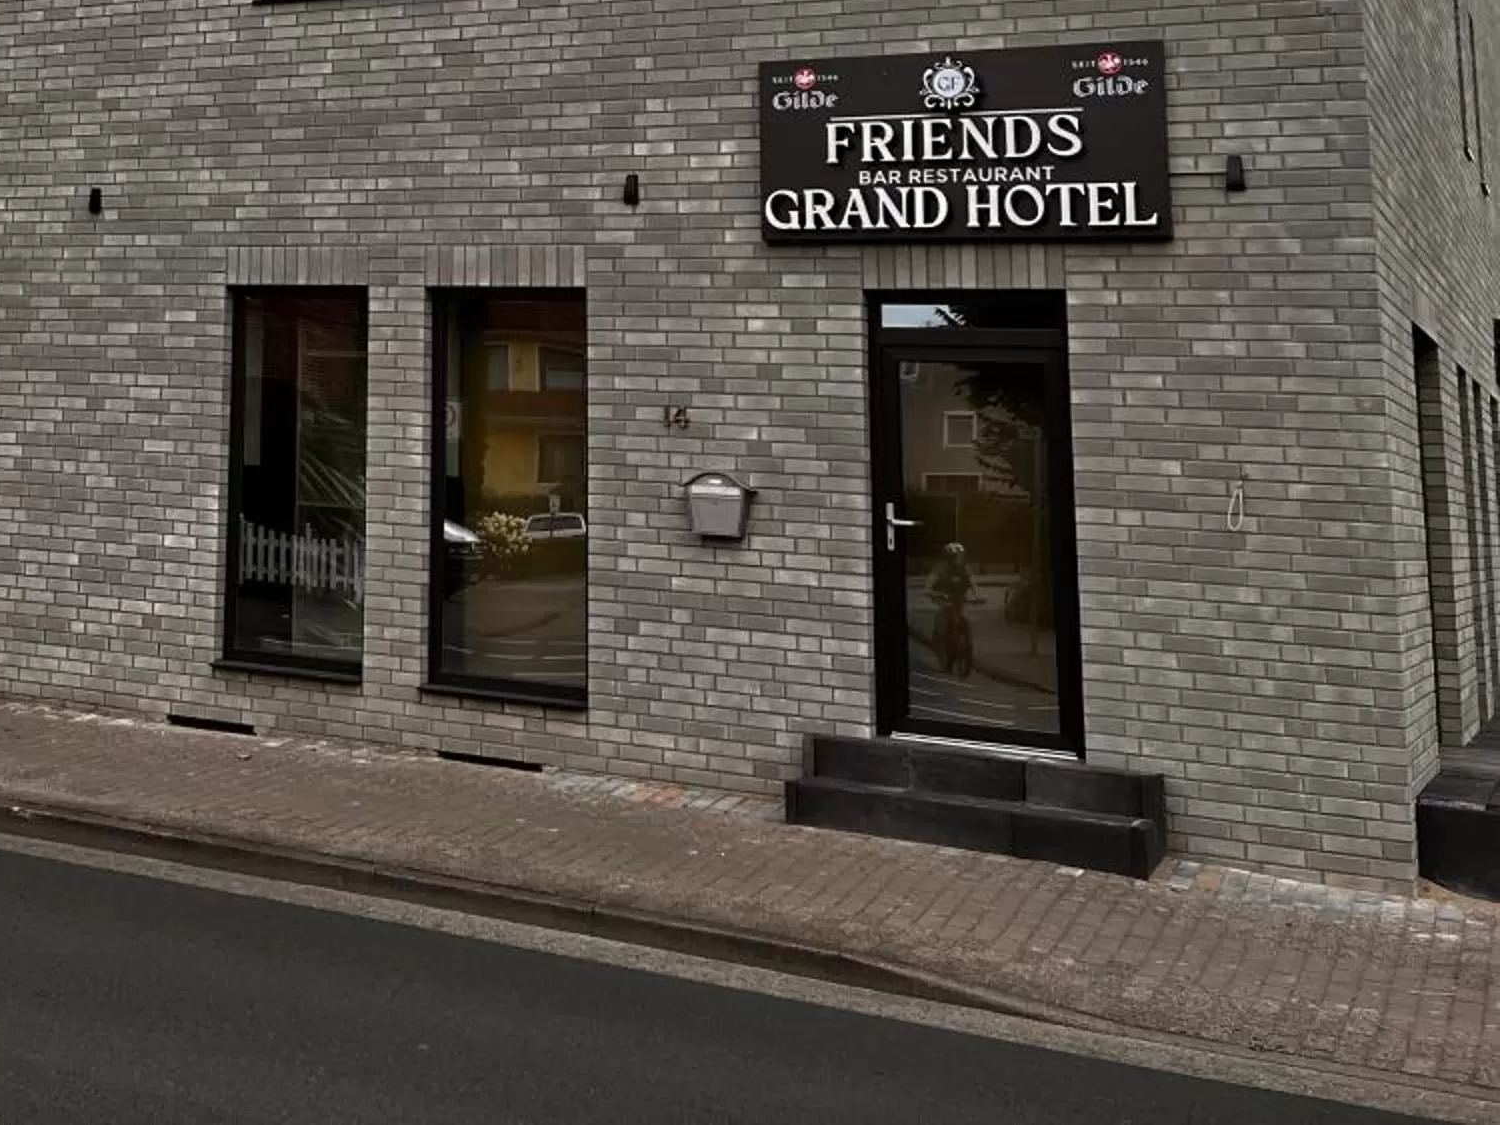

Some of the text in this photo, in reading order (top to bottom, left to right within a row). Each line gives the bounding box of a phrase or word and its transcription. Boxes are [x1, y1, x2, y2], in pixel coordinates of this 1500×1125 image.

[1073, 75, 1149, 98] Gilde
[772, 90, 839, 111] Gilde
[825, 113, 1084, 163] FRIENDS
[859, 166, 1055, 186] BAR RESTAURANT
[765, 182, 1159, 230] GRAND HOTEL
